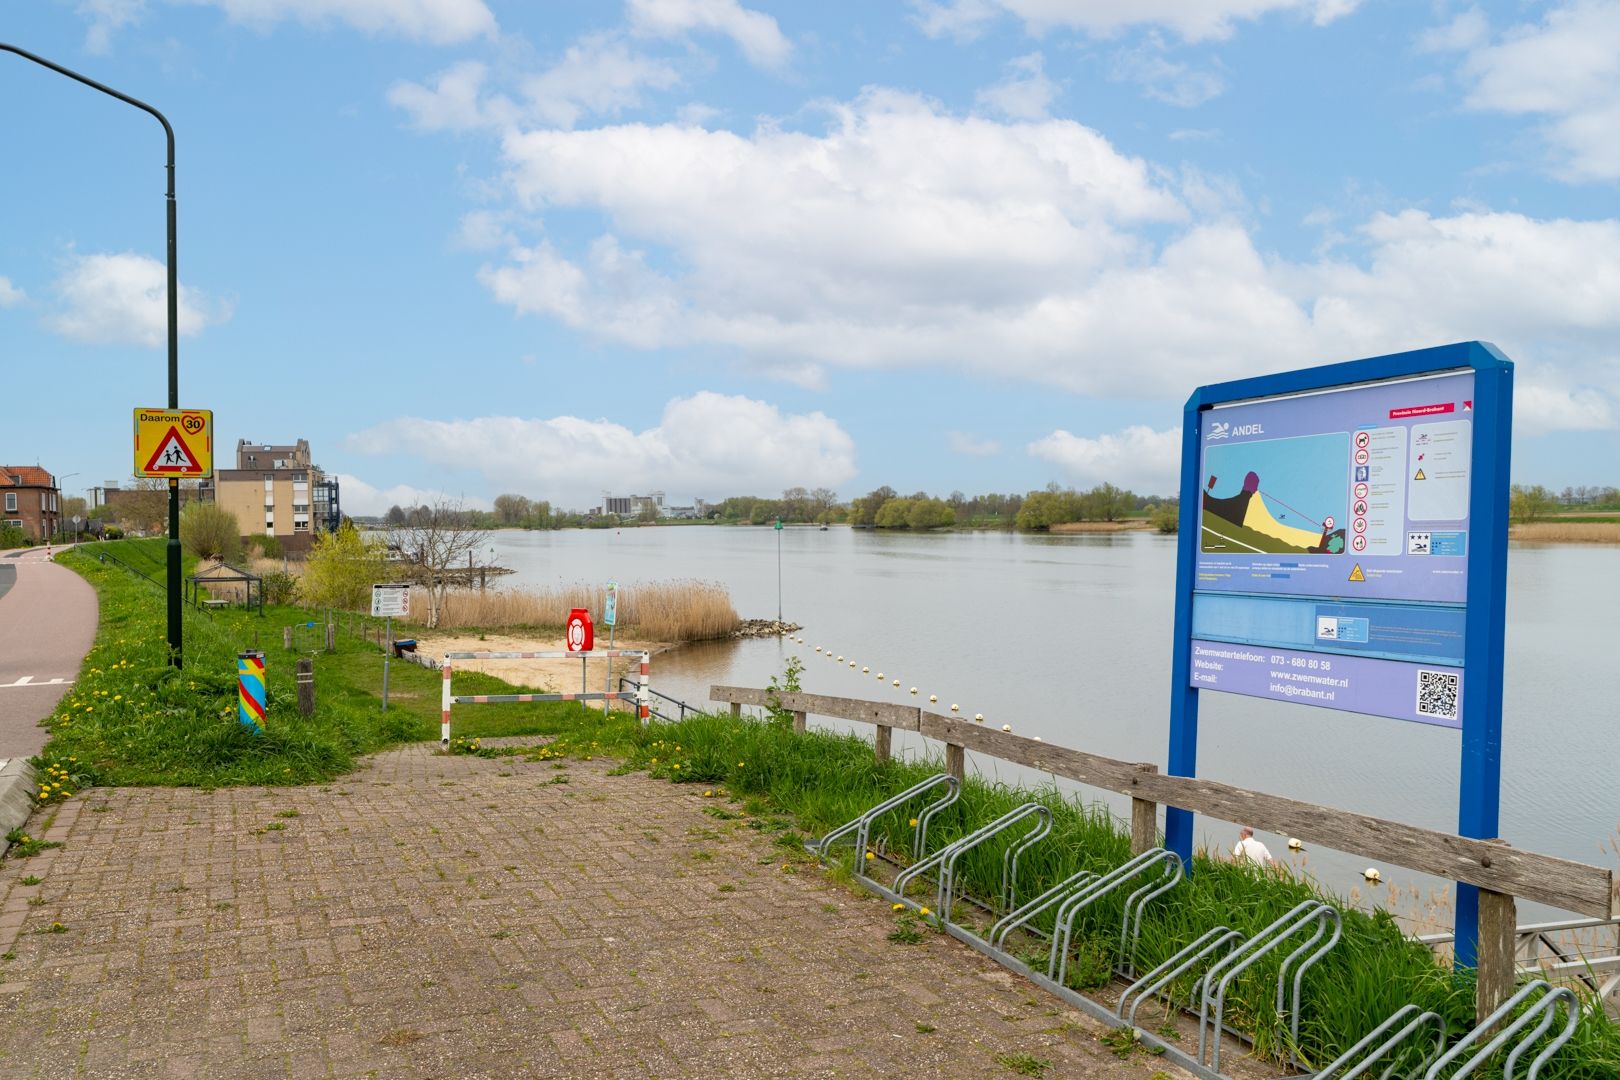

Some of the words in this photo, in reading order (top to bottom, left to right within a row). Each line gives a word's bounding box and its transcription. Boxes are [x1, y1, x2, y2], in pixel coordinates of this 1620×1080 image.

[140, 413, 180, 422] Daarom
[186, 420, 200, 429] 30
[1231, 424, 1265, 437] ANDEL
[1194, 646, 1265, 663] Zwemwatertelefoon:
[1270, 655, 1285, 665] 073
[1291, 657, 1306, 668] 680
[1307, 659, 1319, 669] 80
[1320, 661, 1331, 671] 58
[1194, 659, 1224, 671] Website:
[1270, 670, 1349, 688] www.zwemwater.nl
[1194, 672, 1217, 683] E-mail:
[1270, 682, 1335, 701] info@brabant.nl
